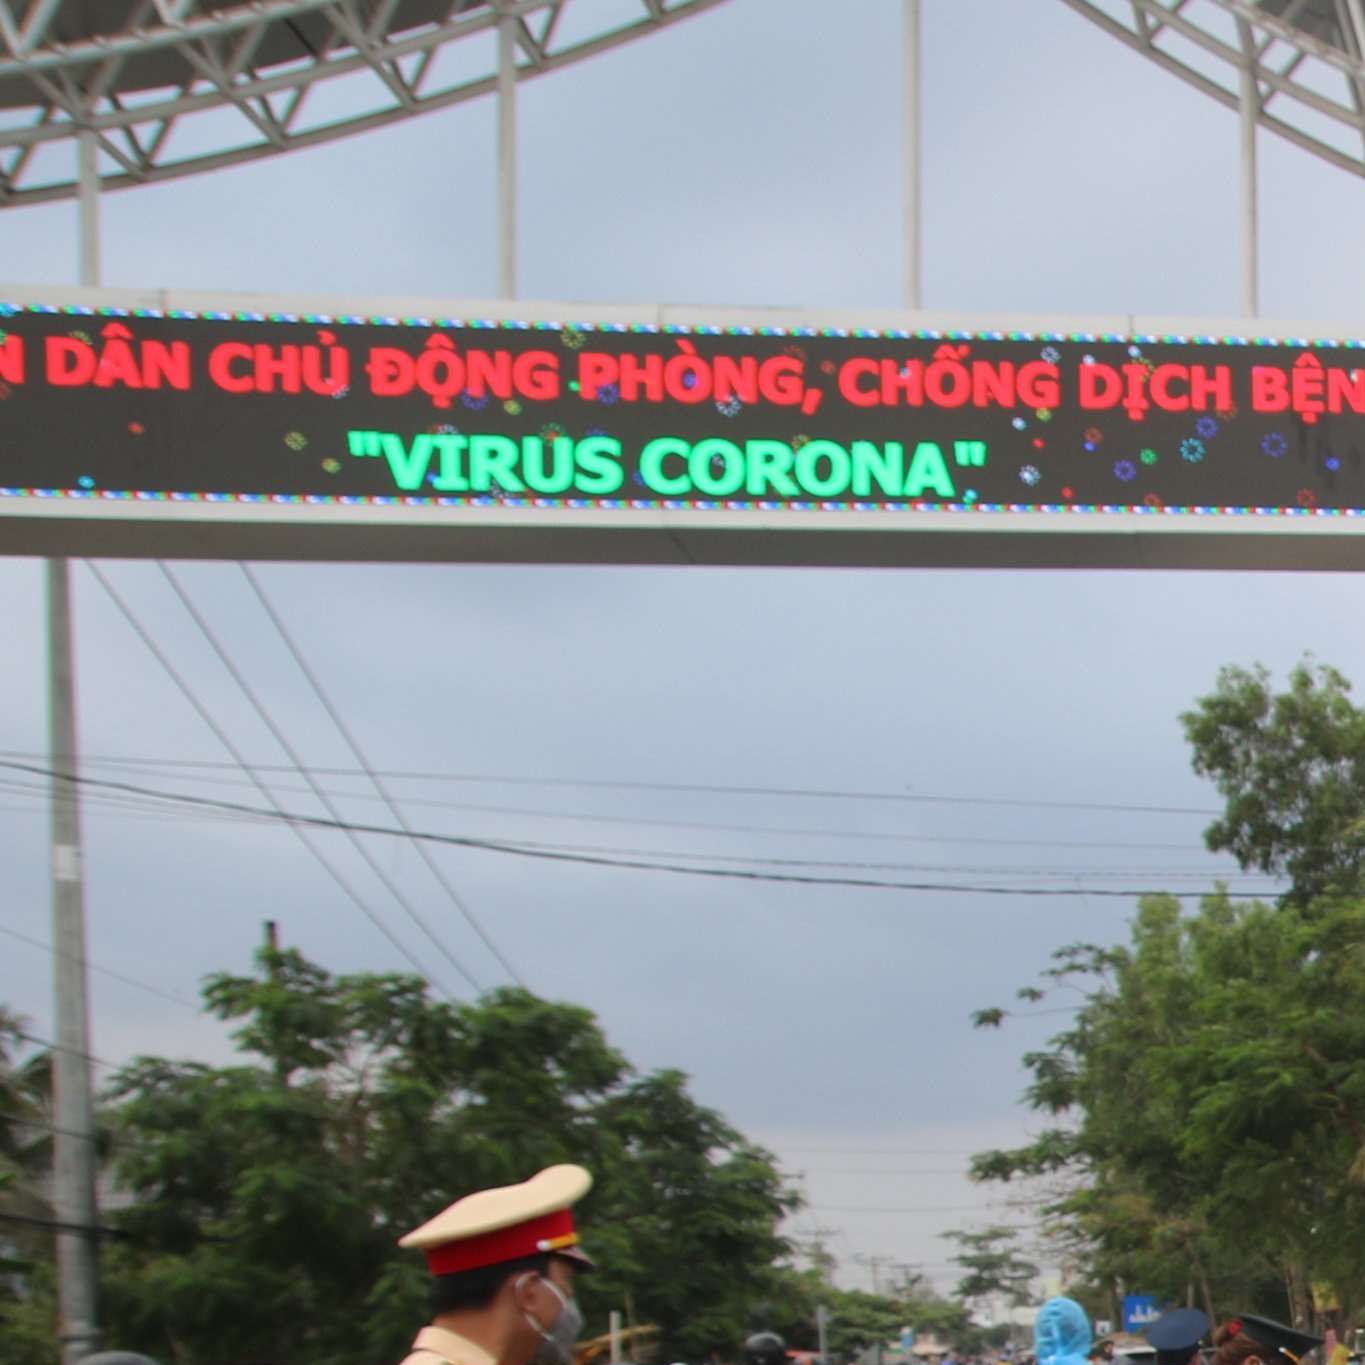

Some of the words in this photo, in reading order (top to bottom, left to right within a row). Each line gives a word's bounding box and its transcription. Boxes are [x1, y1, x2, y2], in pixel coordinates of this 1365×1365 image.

[46, 323, 190, 390] DÂN
[209, 330, 348, 395] CHỦ
[366, 333, 559, 408] ĐỘNG
[578, 340, 821, 414] PHÒNG,
[838, 344, 1060, 410] CHỐNG
[1079, 362, 1232, 420] DỊCH
[348, 430, 622, 494] "VIRUS
[639, 437, 986, 498] CORONA"
